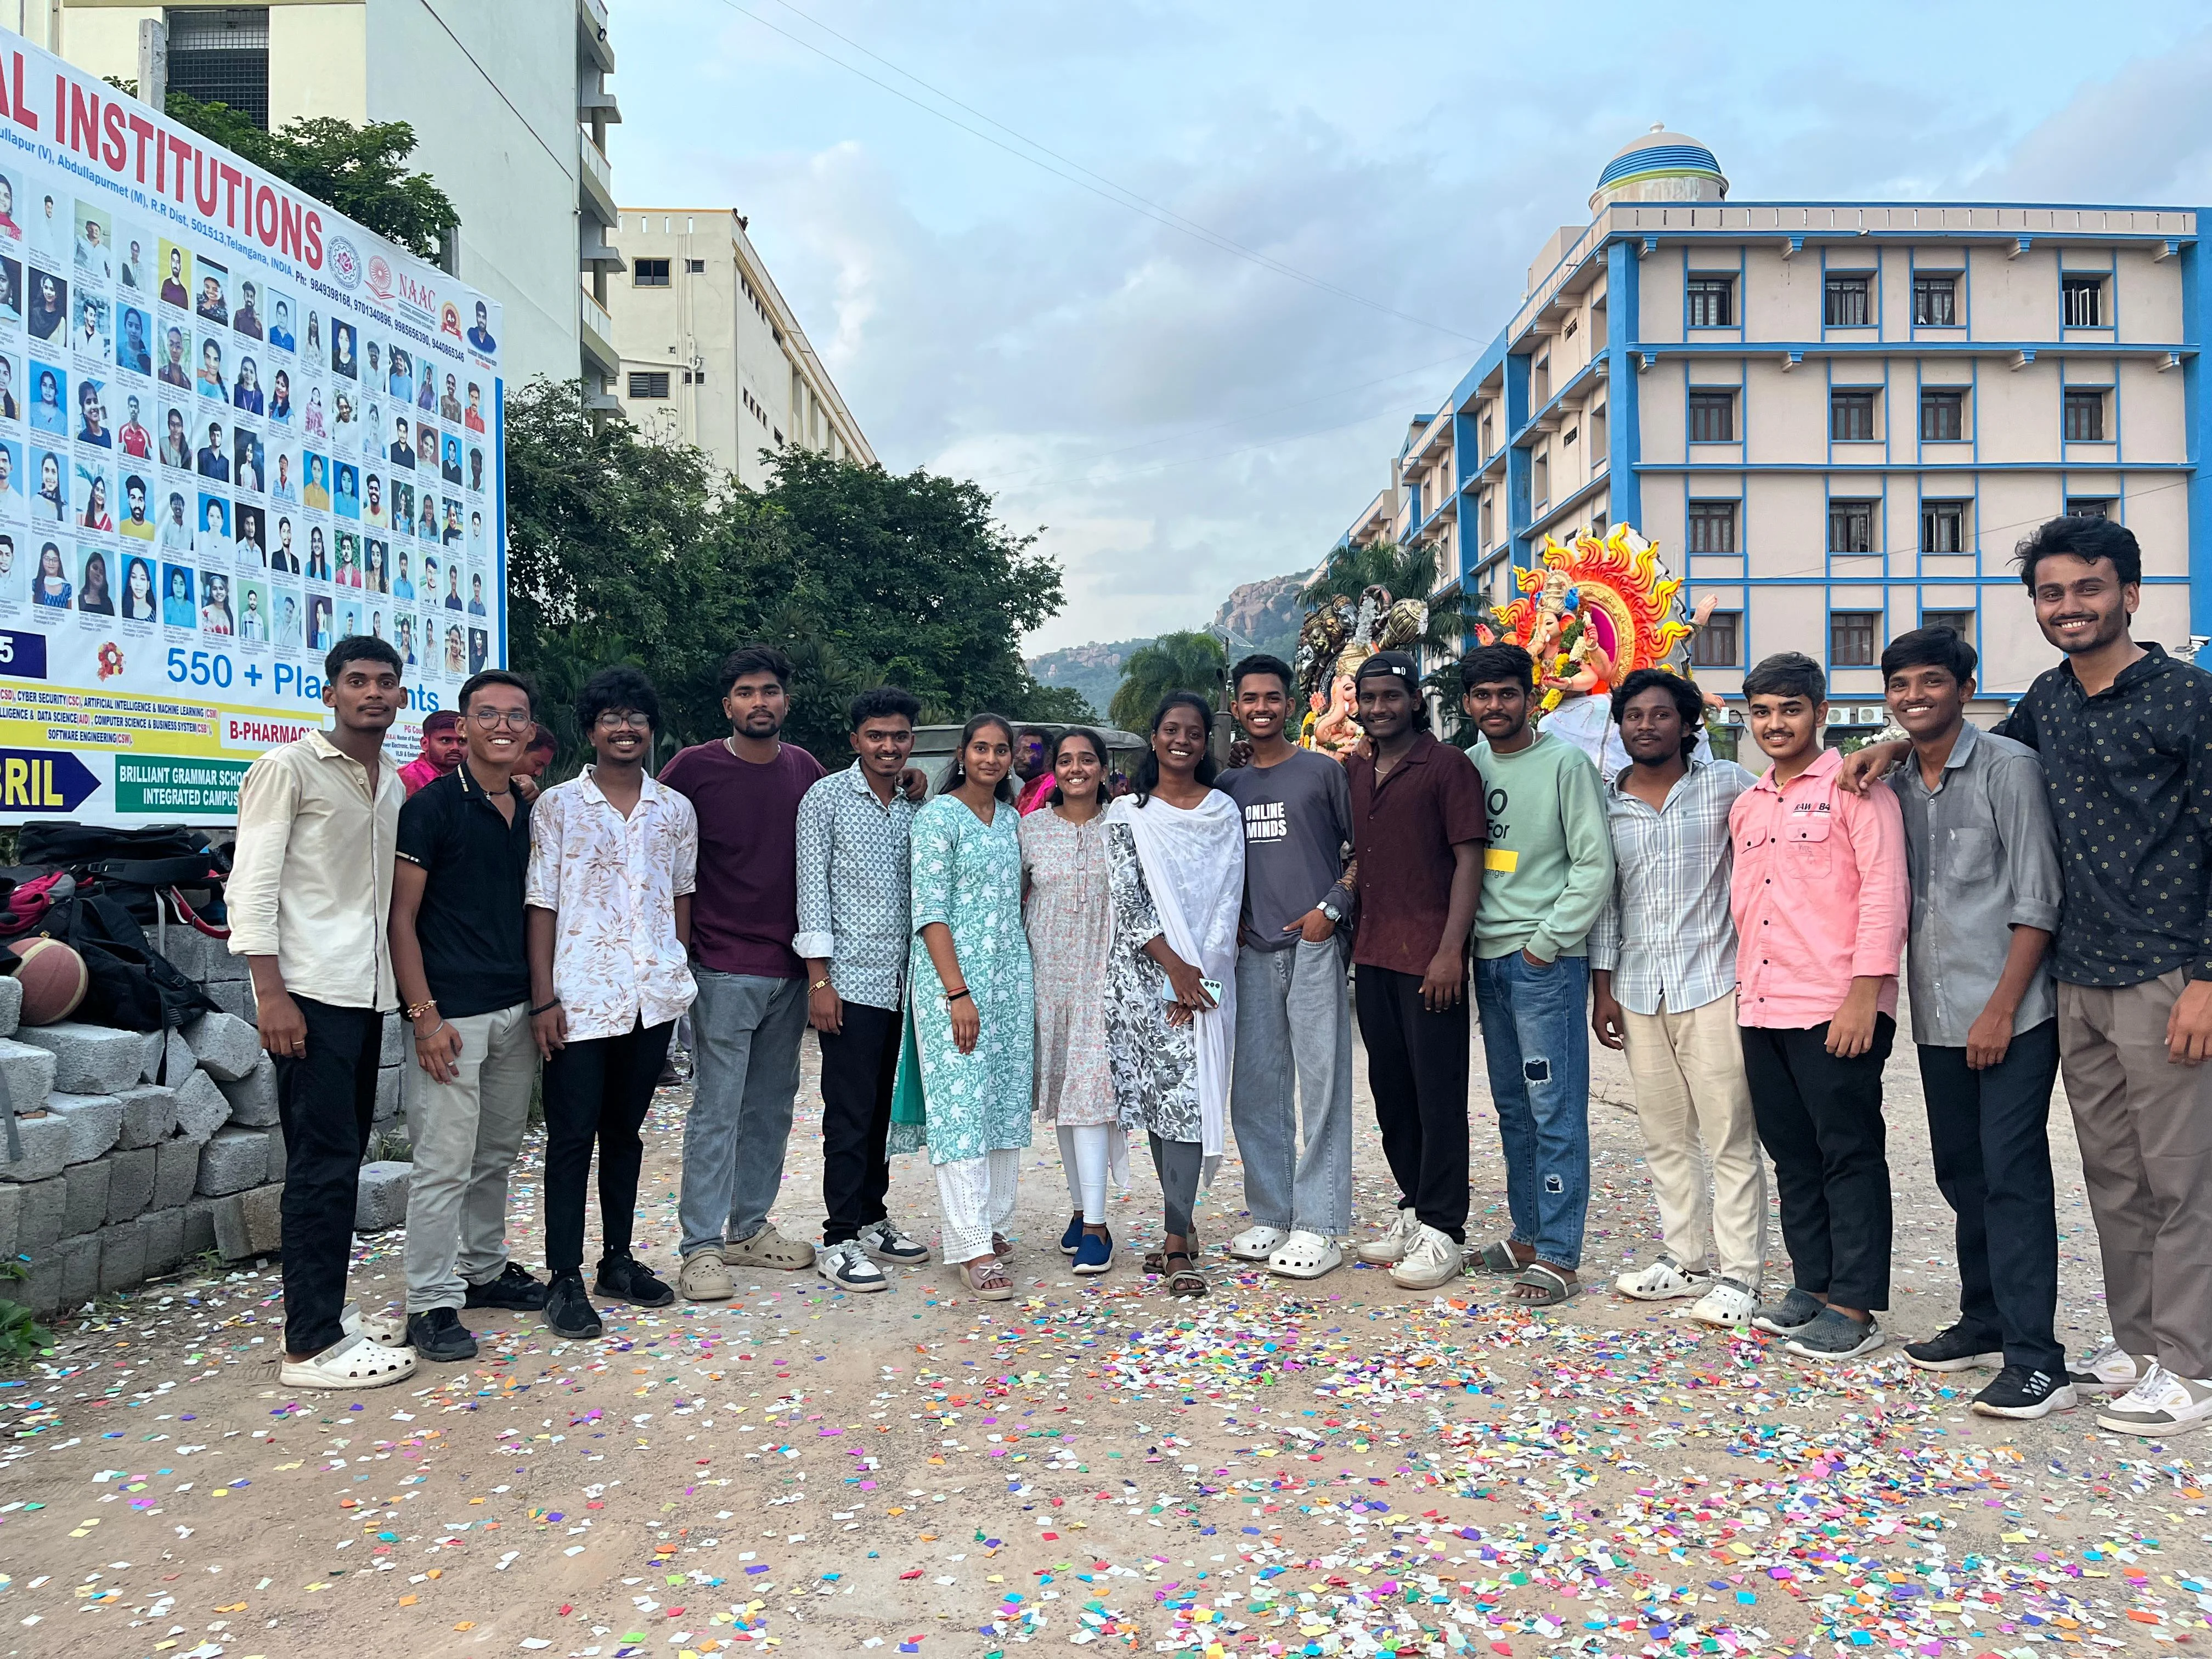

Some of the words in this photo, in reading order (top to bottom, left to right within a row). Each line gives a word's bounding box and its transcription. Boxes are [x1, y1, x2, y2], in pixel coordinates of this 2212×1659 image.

[55, 74, 323, 270] INSTITUTIONS
[38, 144, 54, 166] (V),
[58, 154, 128, 198] Abdullapurmet
[131, 189, 148, 210] (M),
[151, 199, 166, 217] R.R
[170, 207, 188, 228] Dist,
[271, 257, 294, 278] INDIA.
[295, 270, 307, 286] Ph:
[311, 278, 352, 311] 9849398168,
[354, 301, 393, 330] 9701340896,
[394, 319, 431, 349] 9985656390,
[432, 338, 465, 363] 9440865346
[399, 273, 436, 313] NAAC
[0, 636, 14, 663] 5
[167, 647, 233, 688] 550
[244, 664, 263, 687] +
[274, 663, 439, 712] Plants
[18, 690, 37, 702] CYBER
[84, 697, 113, 709] ARTIFICIAL
[114, 700, 151, 713] INTELLIGENCE
[153, 703, 156, 713] &
[157, 704, 179, 715] MACHINE
[180, 706, 204, 717] LEARNING
[30, 710, 34, 720] &
[37, 710, 52, 721] DATA
[94, 715, 123, 727] COMPUTER
[125, 717, 146, 729] SCIENCE
[148, 719, 151, 729] &
[153, 719, 177, 731] BUSINESS
[230, 720, 314, 743] B-PHARMAC
[404, 725, 411, 733] PG
[48, 729, 78, 741] SOFTWARE
[0, 758, 64, 806] RIL
[120, 765, 170, 783] BRILLIANT
[172, 768, 217, 786] GRAMMAR
[143, 788, 200, 805] INTEGRATED
[202, 790, 239, 806] CAMPUS
[1245, 802, 1285, 821] ONLINE
[1246, 819, 1287, 839] MINDS
